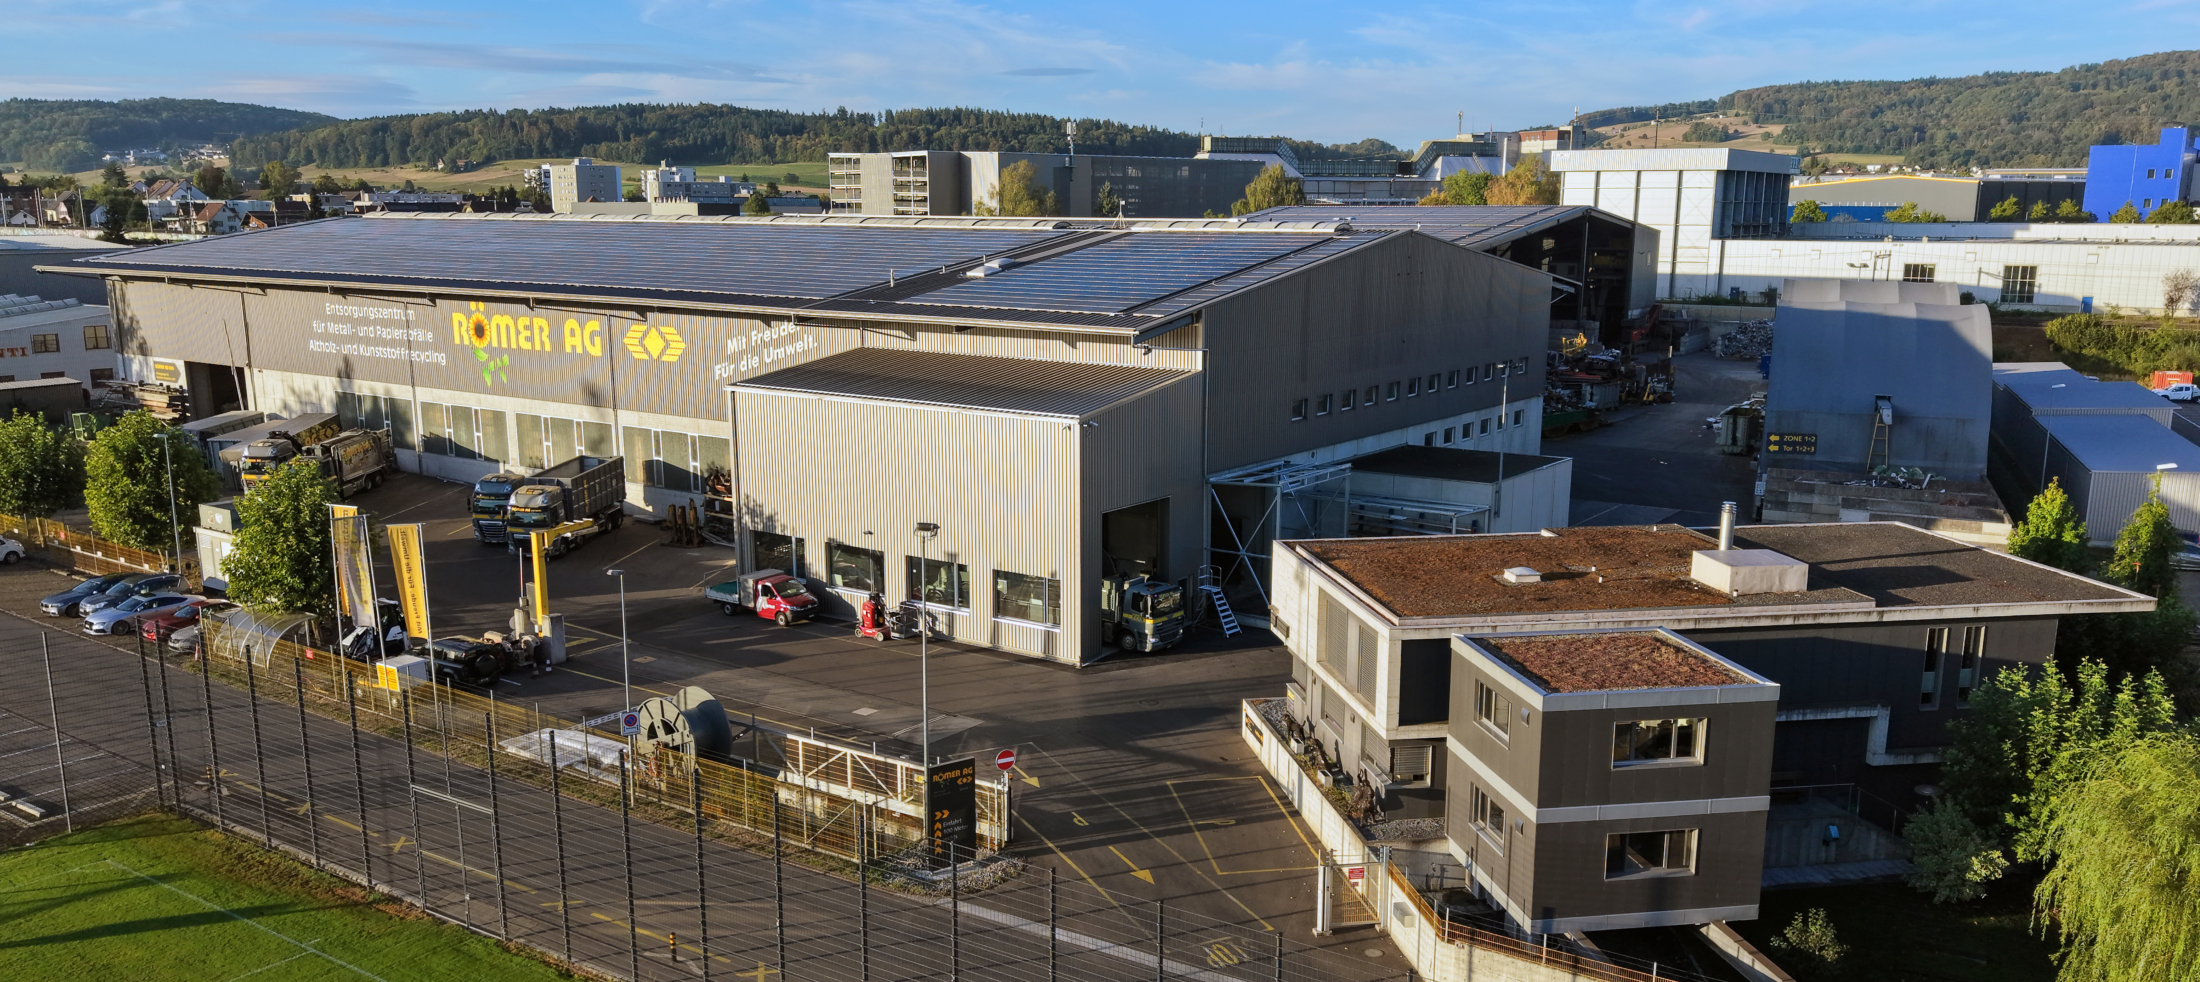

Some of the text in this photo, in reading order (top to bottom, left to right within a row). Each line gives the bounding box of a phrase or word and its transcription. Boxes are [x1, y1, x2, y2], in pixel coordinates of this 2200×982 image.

[325, 302, 415, 320] Entsorgungszentrum
[313, 320, 433, 342] für Metall- und Papierabfälle
[452, 301, 602, 357] RÖMER AG
[727, 320, 800, 354] Mit Freude.
[309, 339, 446, 365] Altholz- und Kunststoffrecycling
[715, 334, 818, 380] Für die Umwelt.
[963, 767, 973, 775] AG
